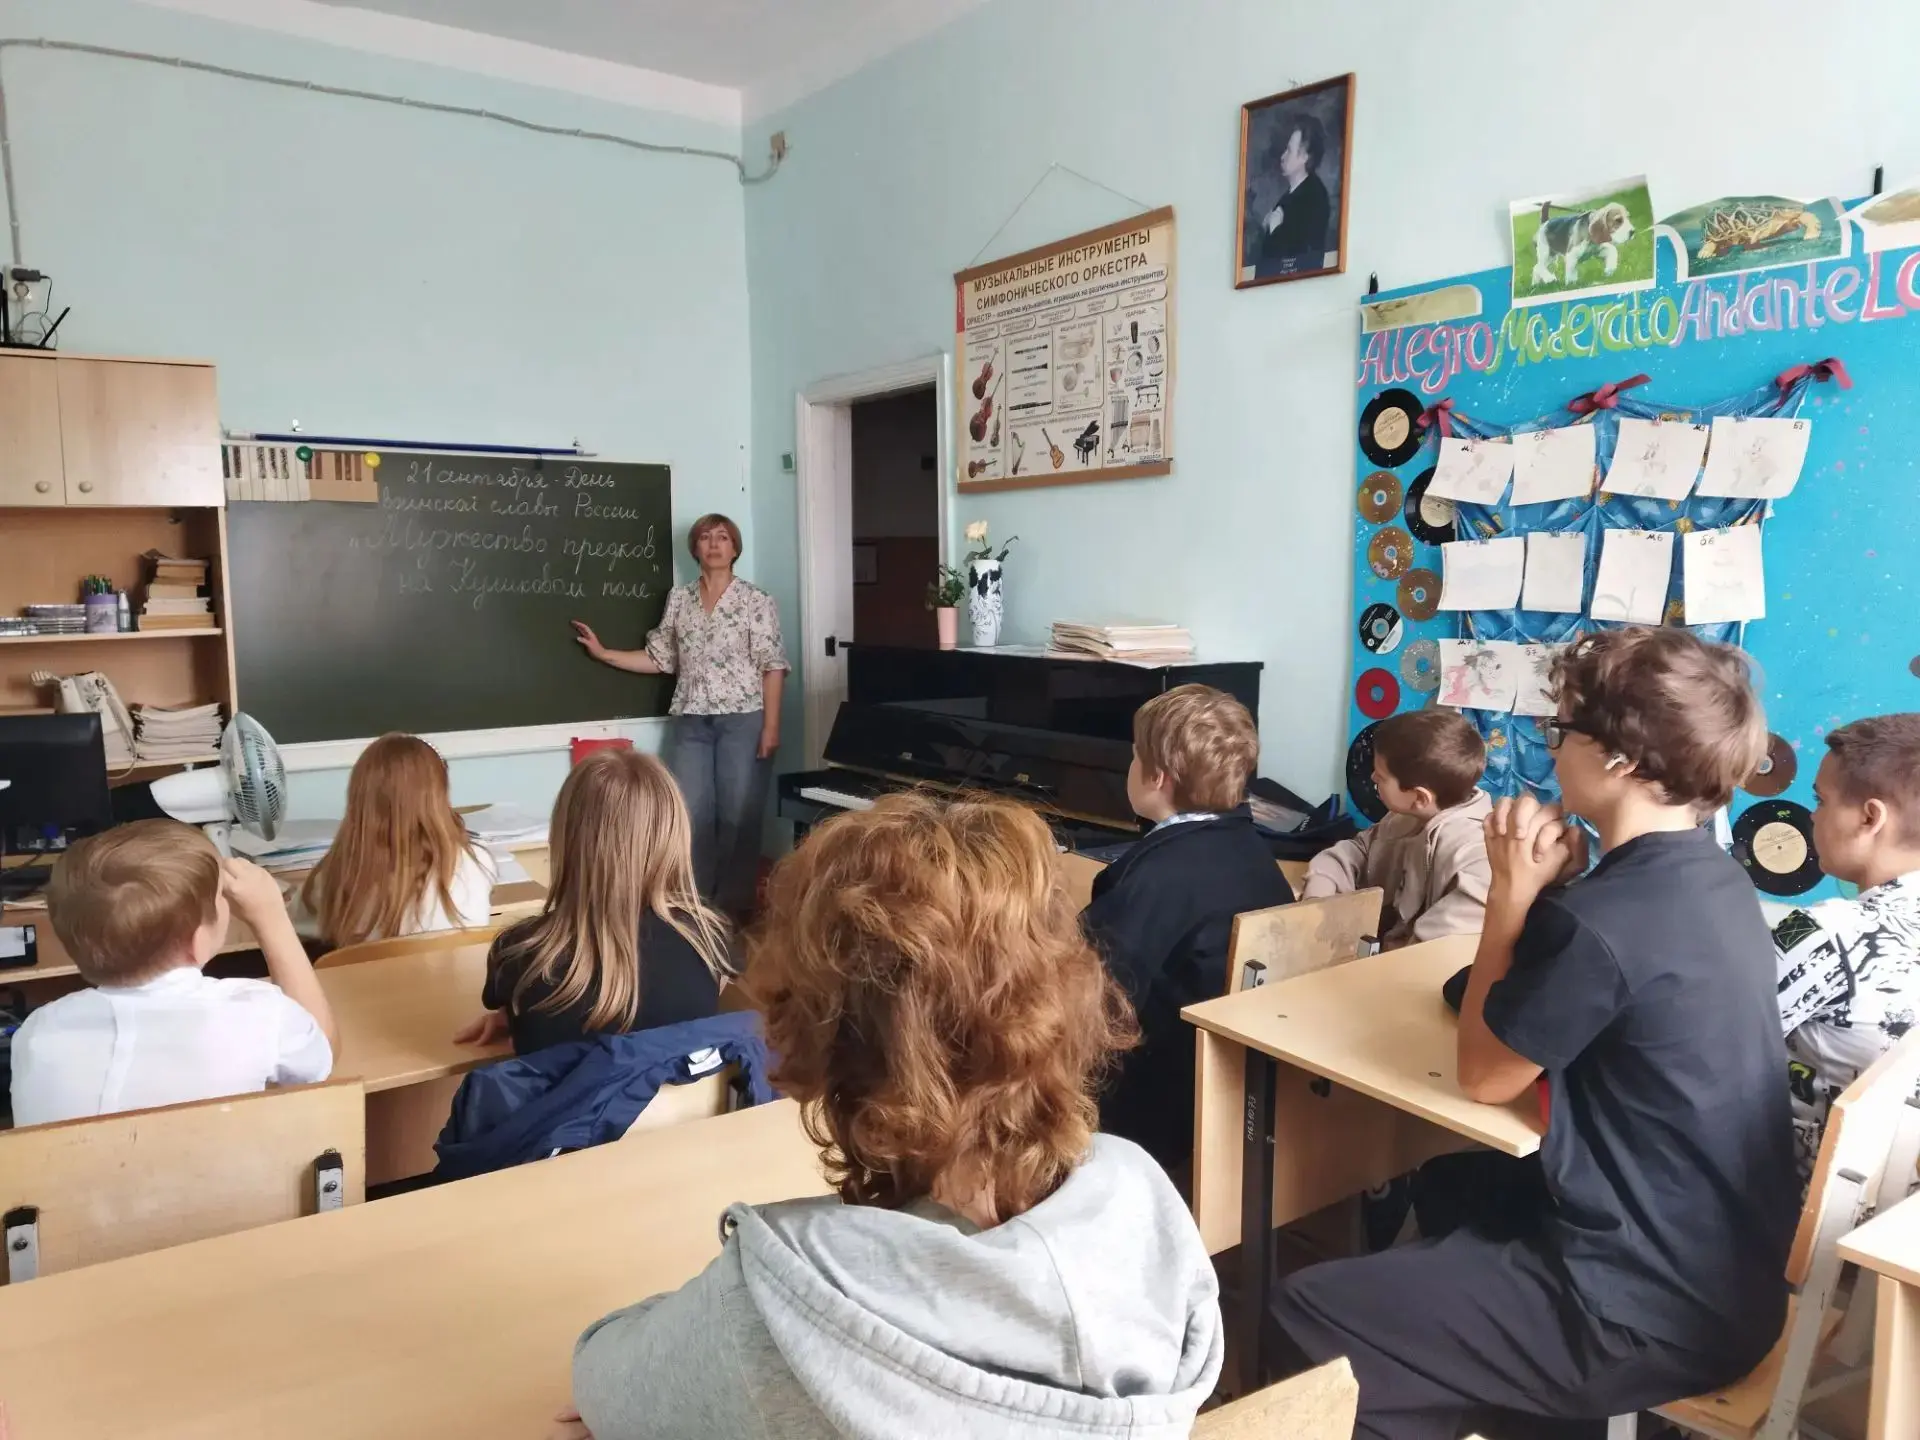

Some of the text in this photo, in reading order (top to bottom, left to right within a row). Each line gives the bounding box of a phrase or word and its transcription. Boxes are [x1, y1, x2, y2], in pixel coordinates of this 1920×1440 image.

[974, 230, 1150, 293] МУЗЫКАЛЬНЫЕ ИНСТРУМЕНТЫ
[976, 271, 1079, 310] СИМФОНИЧЕСКОГО
[1083, 252, 1148, 282] ОРКЕСТРА
[967, 313, 992, 325] ОРКЕСТР
[1668, 262, 1861, 348] Andante
[406, 461, 432, 483] 21
[564, 465, 615, 488] День
[574, 491, 640, 519] России
